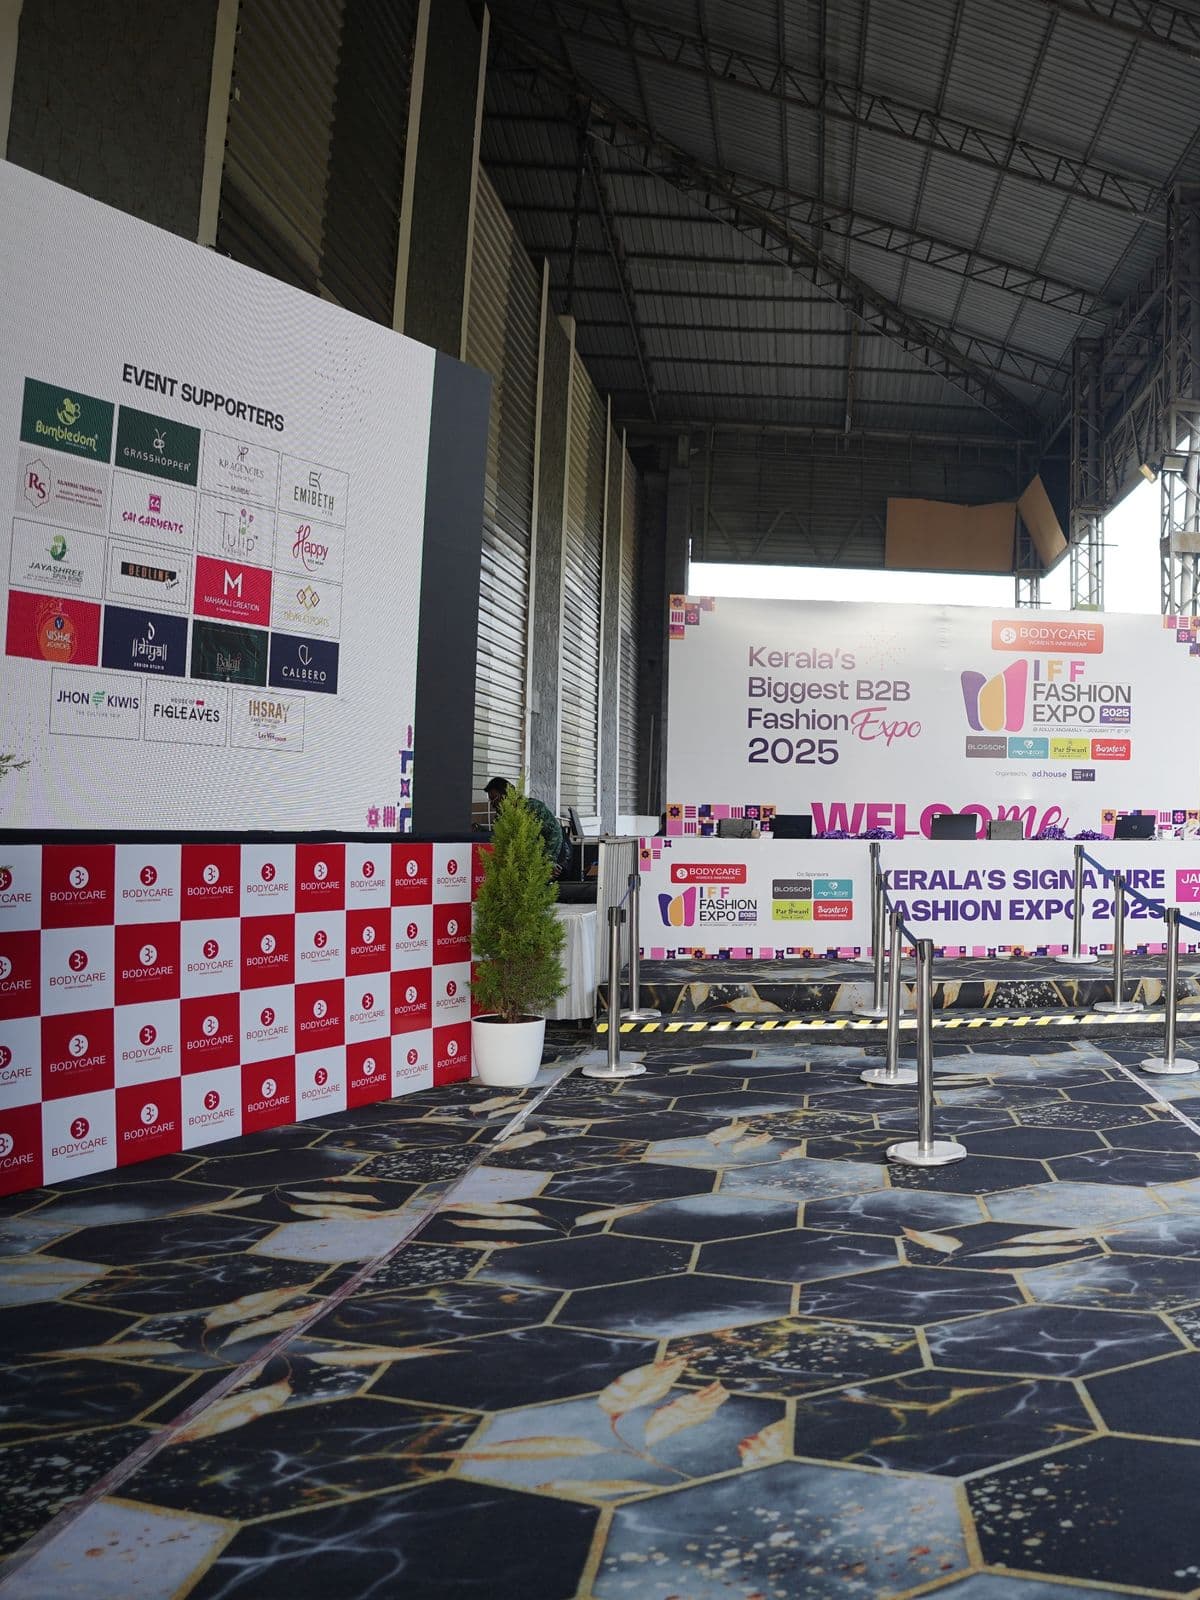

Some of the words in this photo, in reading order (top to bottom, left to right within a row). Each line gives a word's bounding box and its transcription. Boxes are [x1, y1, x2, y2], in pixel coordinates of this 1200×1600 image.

[122, 363, 178, 396] EVENT
[181, 383, 285, 432] SUPPORTERS
[35, 419, 97, 452] Bumbledom
[124, 447, 190, 471] GRASSHOPPER
[122, 511, 136, 523] SAI
[138, 515, 184, 534] GARMENTS
[29, 561, 85, 577] JAYASHREE
[1020, 627, 1096, 641] BODYCARE
[748, 646, 856, 670] Kerala's
[282, 666, 327, 682] CALBERO
[748, 677, 849, 704] Biggest
[856, 680, 911, 702] B2B
[1032, 683, 1131, 703] FASHION
[56, 690, 90, 705] JHON
[107, 695, 139, 709] KIWIS
[153, 704, 220, 723] FIGLEAVES
[1032, 704, 1096, 723] EXPO
[1101, 708, 1130, 718] 2025
[747, 707, 849, 731] Fashion
[850, 706, 922, 747] Expo
[748, 737, 839, 765] 2025
[1031, 770, 1067, 778] ad.house
[689, 868, 741, 876] BODYCARE
[300, 881, 340, 891] BODYCARE
[350, 879, 385, 889] BODYCARE
[395, 877, 428, 887] BODYCARE
[437, 876, 467, 885] BODYCARE
[122, 888, 173, 899] BODYCARE
[187, 886, 234, 896] BODYCARE
[247, 883, 289, 893] BODYCARE
[50, 890, 106, 902] BODYCARE
[699, 899, 757, 910] FASHION
[885, 899, 1001, 921] ASHION
[1009, 900, 1077, 921] EXPO
[699, 911, 736, 922] EXPO
[395, 939, 428, 950] BODYCARE
[437, 936, 468, 946] BODYCARE
[300, 949, 339, 960] BODYCARE
[350, 944, 386, 955] BODYCARE
[187, 960, 233, 972] BODYCARE
[247, 954, 289, 966] BODYCARE
[50, 972, 106, 986] BODYCARE
[122, 966, 173, 979] BODYCARE
[395, 1002, 427, 1015] BODYCARE
[436, 996, 467, 1007] BODYCARE
[350, 1009, 385, 1022] BODYCARE
[300, 1017, 339, 1031] BODYCARE
[246, 1026, 289, 1039] BODYCARE
[187, 1035, 234, 1049] BODYCARE
[122, 1045, 173, 1060] BODYCARE
[50, 1056, 106, 1073] BODYCARE
[437, 1055, 468, 1068] BODYCARE
[396, 1064, 429, 1078] BODYCARE
[351, 1074, 387, 1089] BODYCARE
[301, 1084, 340, 1100] BODYCARE
[248, 1096, 290, 1112] BODYCARE
[188, 1108, 235, 1126] BODYCARE
[124, 1122, 175, 1141] BODYCARE
[51, 1137, 108, 1157] BODYCARE
